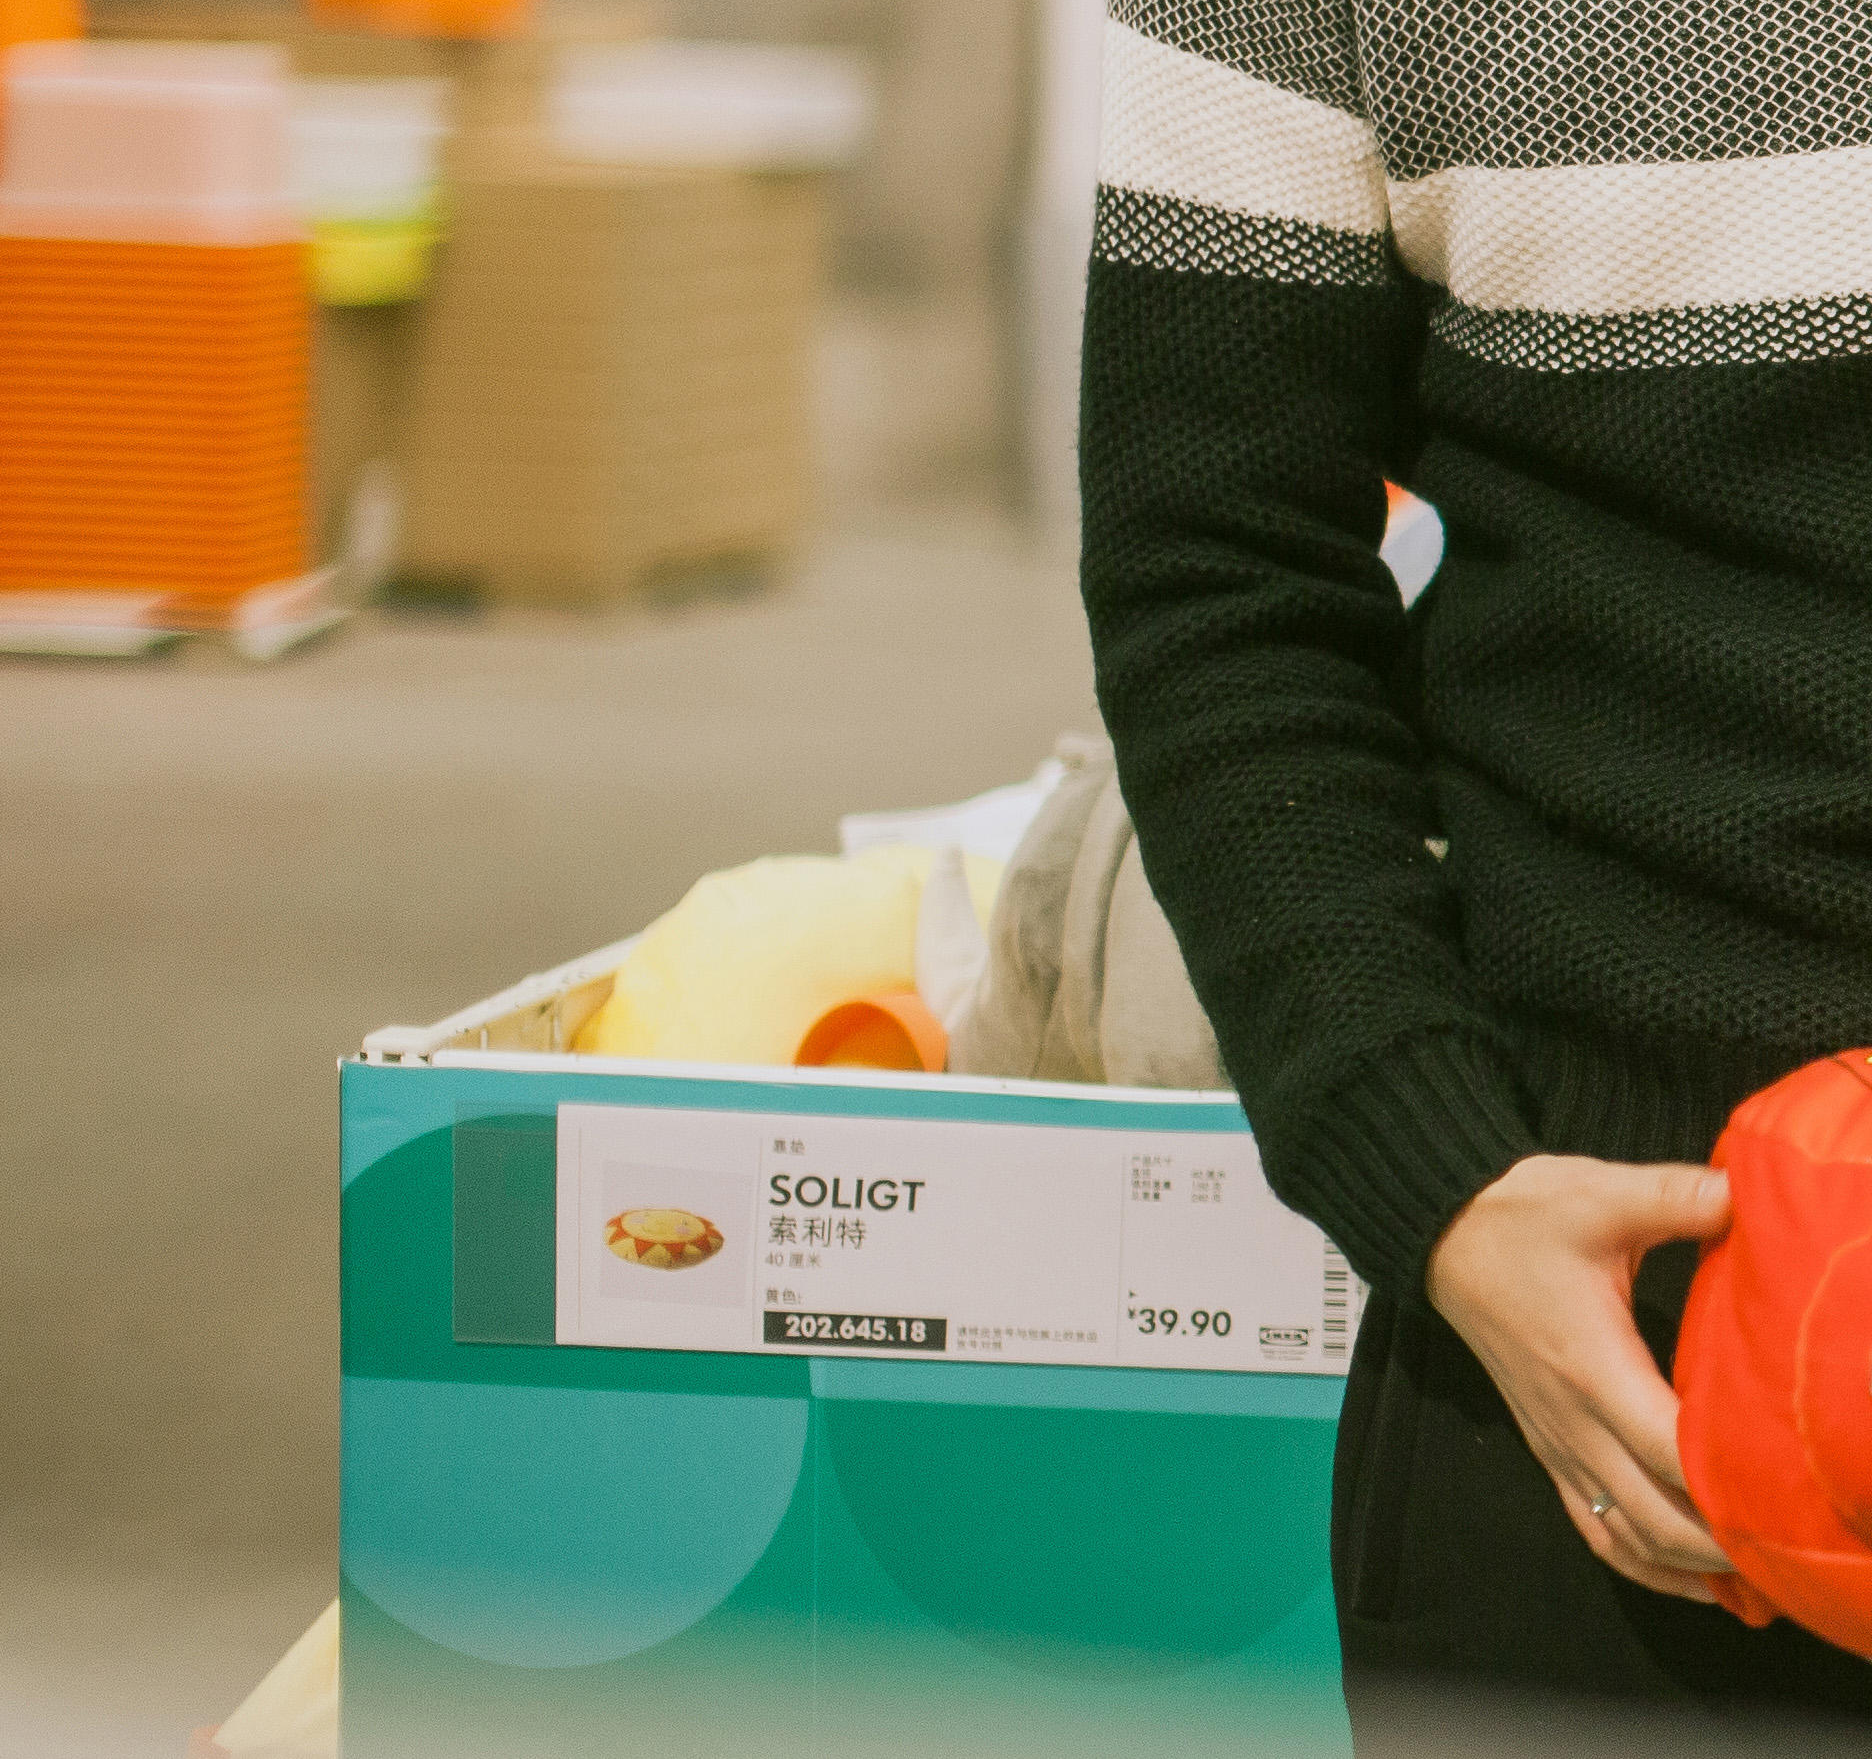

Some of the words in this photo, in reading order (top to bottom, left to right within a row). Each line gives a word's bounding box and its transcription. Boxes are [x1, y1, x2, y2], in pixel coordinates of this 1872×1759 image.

[769, 1173, 926, 1212] SOLIGT
[768, 1214, 867, 1250] 索利特
[765, 1252, 784, 1267] 40
[785, 1315, 927, 1343] 202.645.18
[1128, 1308, 1232, 1338] ¥39.90
